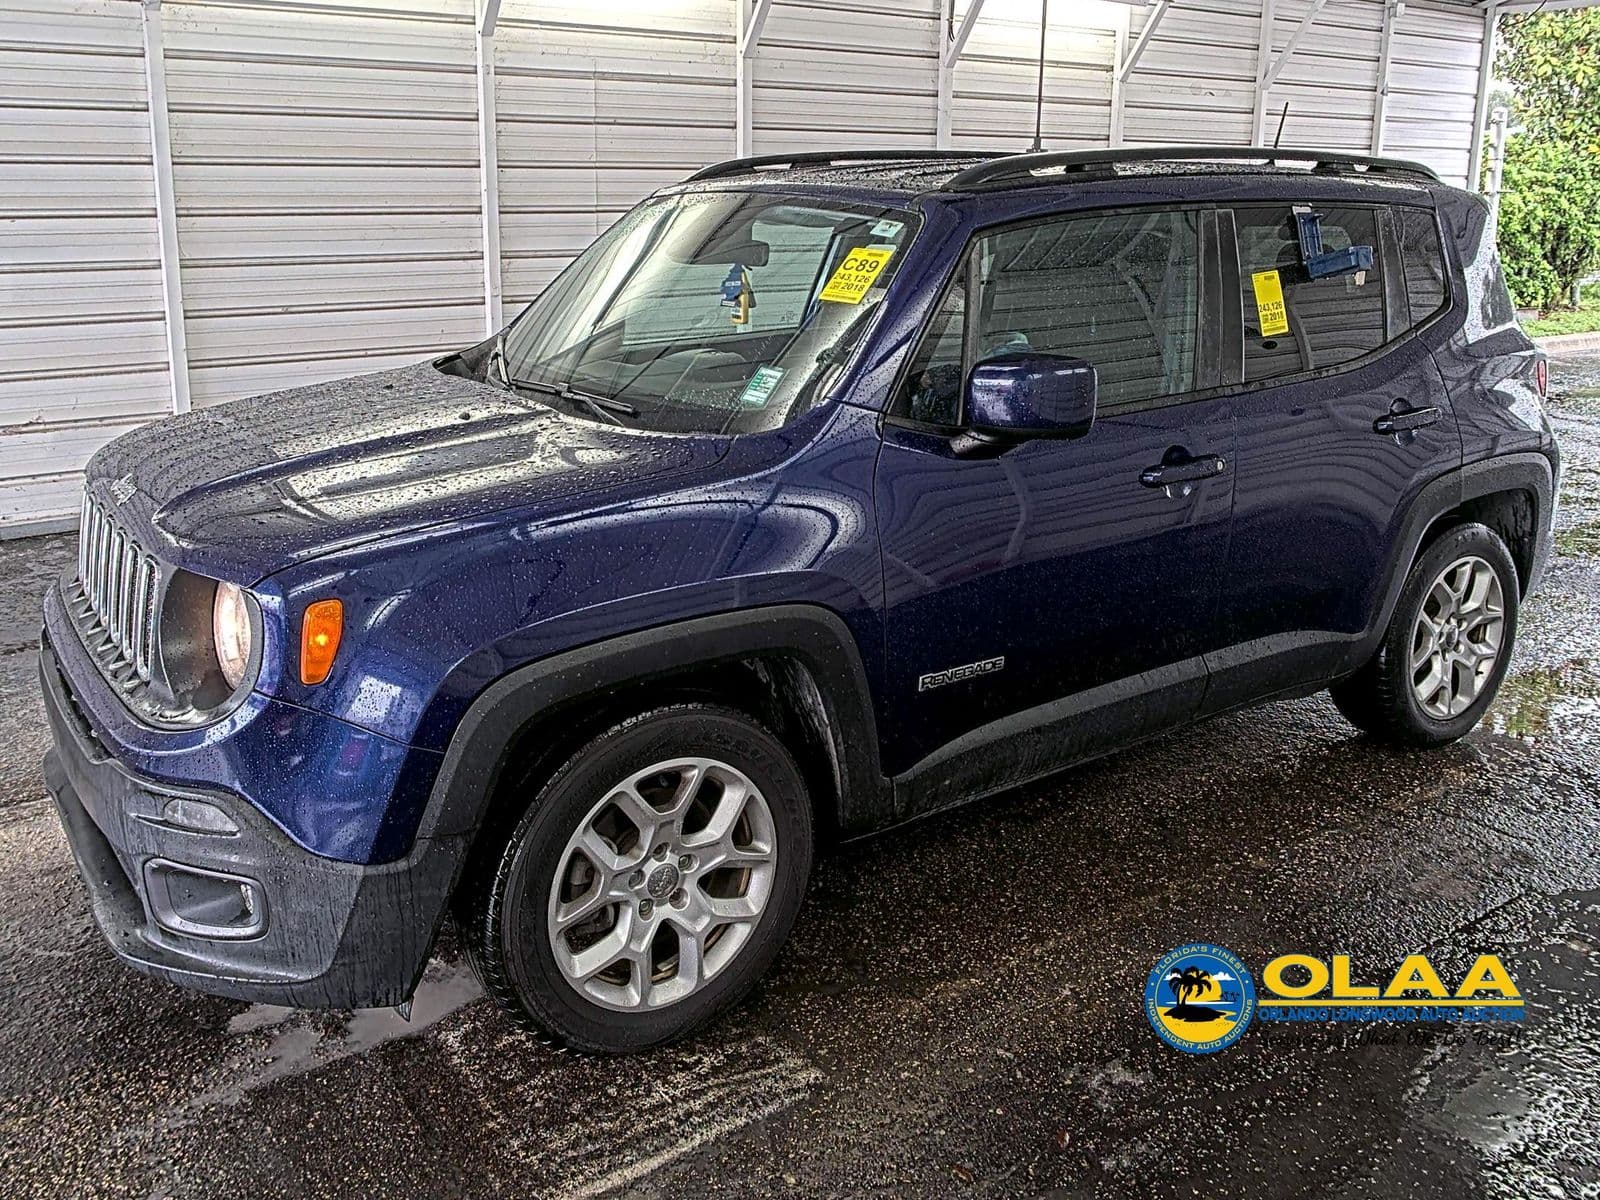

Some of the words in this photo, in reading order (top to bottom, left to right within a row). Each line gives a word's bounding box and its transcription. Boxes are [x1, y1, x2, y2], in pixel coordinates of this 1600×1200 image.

[843, 257, 880, 273] C89
[833, 272, 872, 284] 243,126
[841, 282, 866, 292] 2018
[919, 656, 1005, 692] RENEGADE
